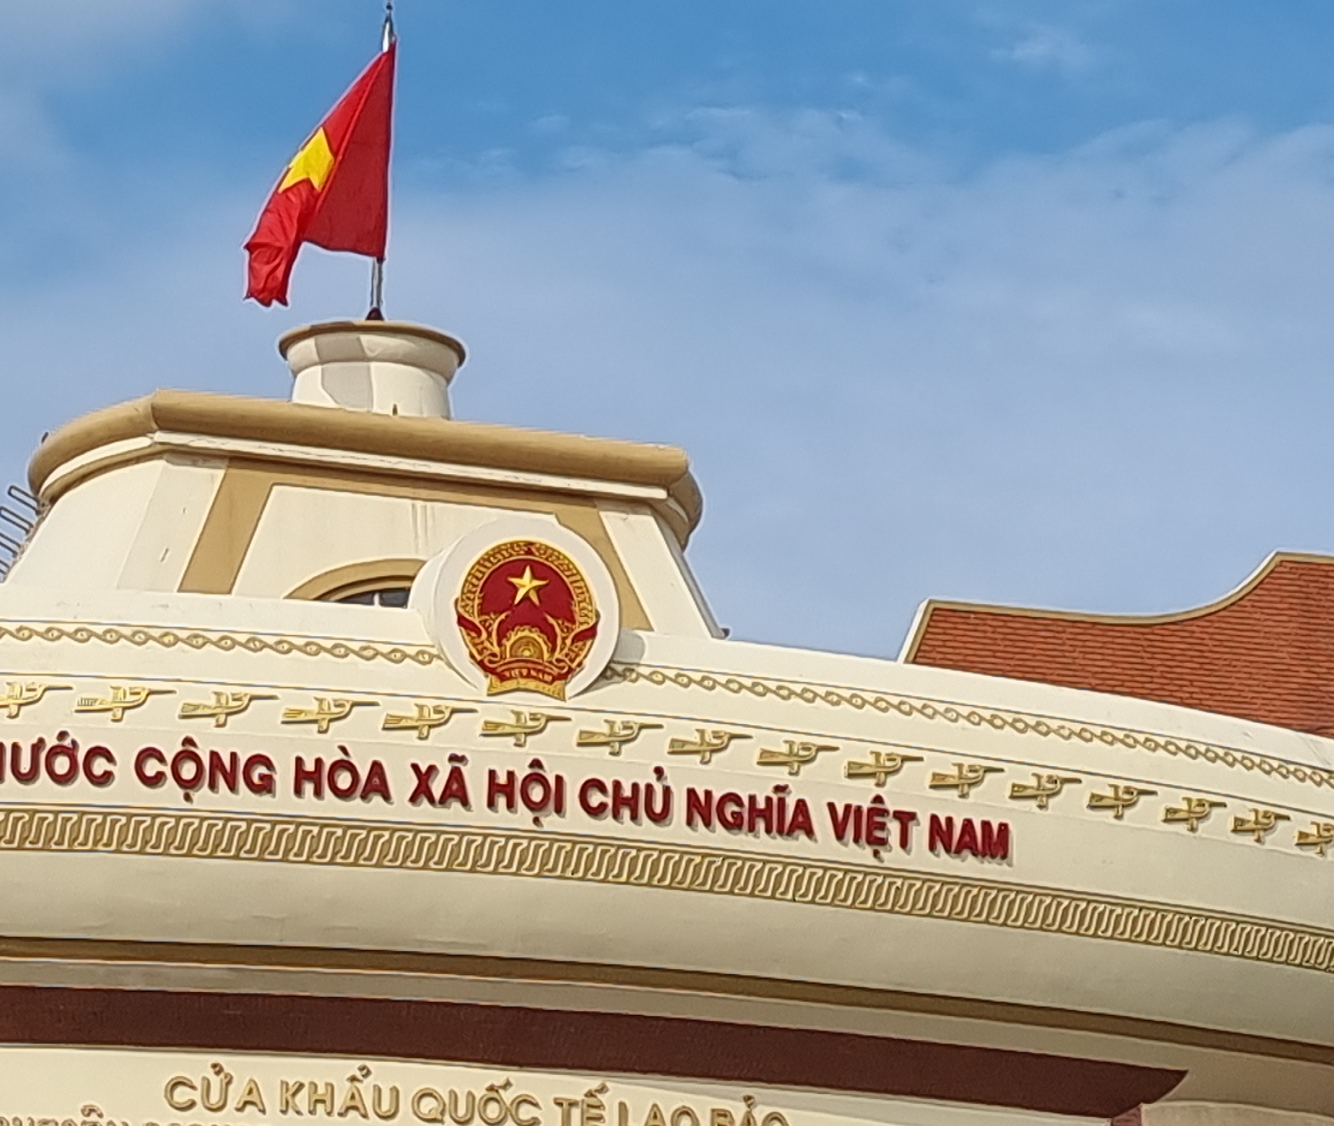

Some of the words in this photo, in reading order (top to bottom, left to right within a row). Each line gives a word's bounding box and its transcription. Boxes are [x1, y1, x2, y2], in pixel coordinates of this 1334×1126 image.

[134, 736, 276, 801] CỘNG
[293, 746, 391, 803] HÒA
[408, 754, 471, 808] XÃ
[486, 759, 566, 827] HỘI
[578, 766, 673, 827] CHỦ
[685, 784, 818, 839] NGHĨA
[827, 794, 917, 860] VIỆT
[928, 813, 1012, 861] NAM
[164, 1061, 265, 1113] CỬA
[280, 1064, 400, 1121] KHẨU
